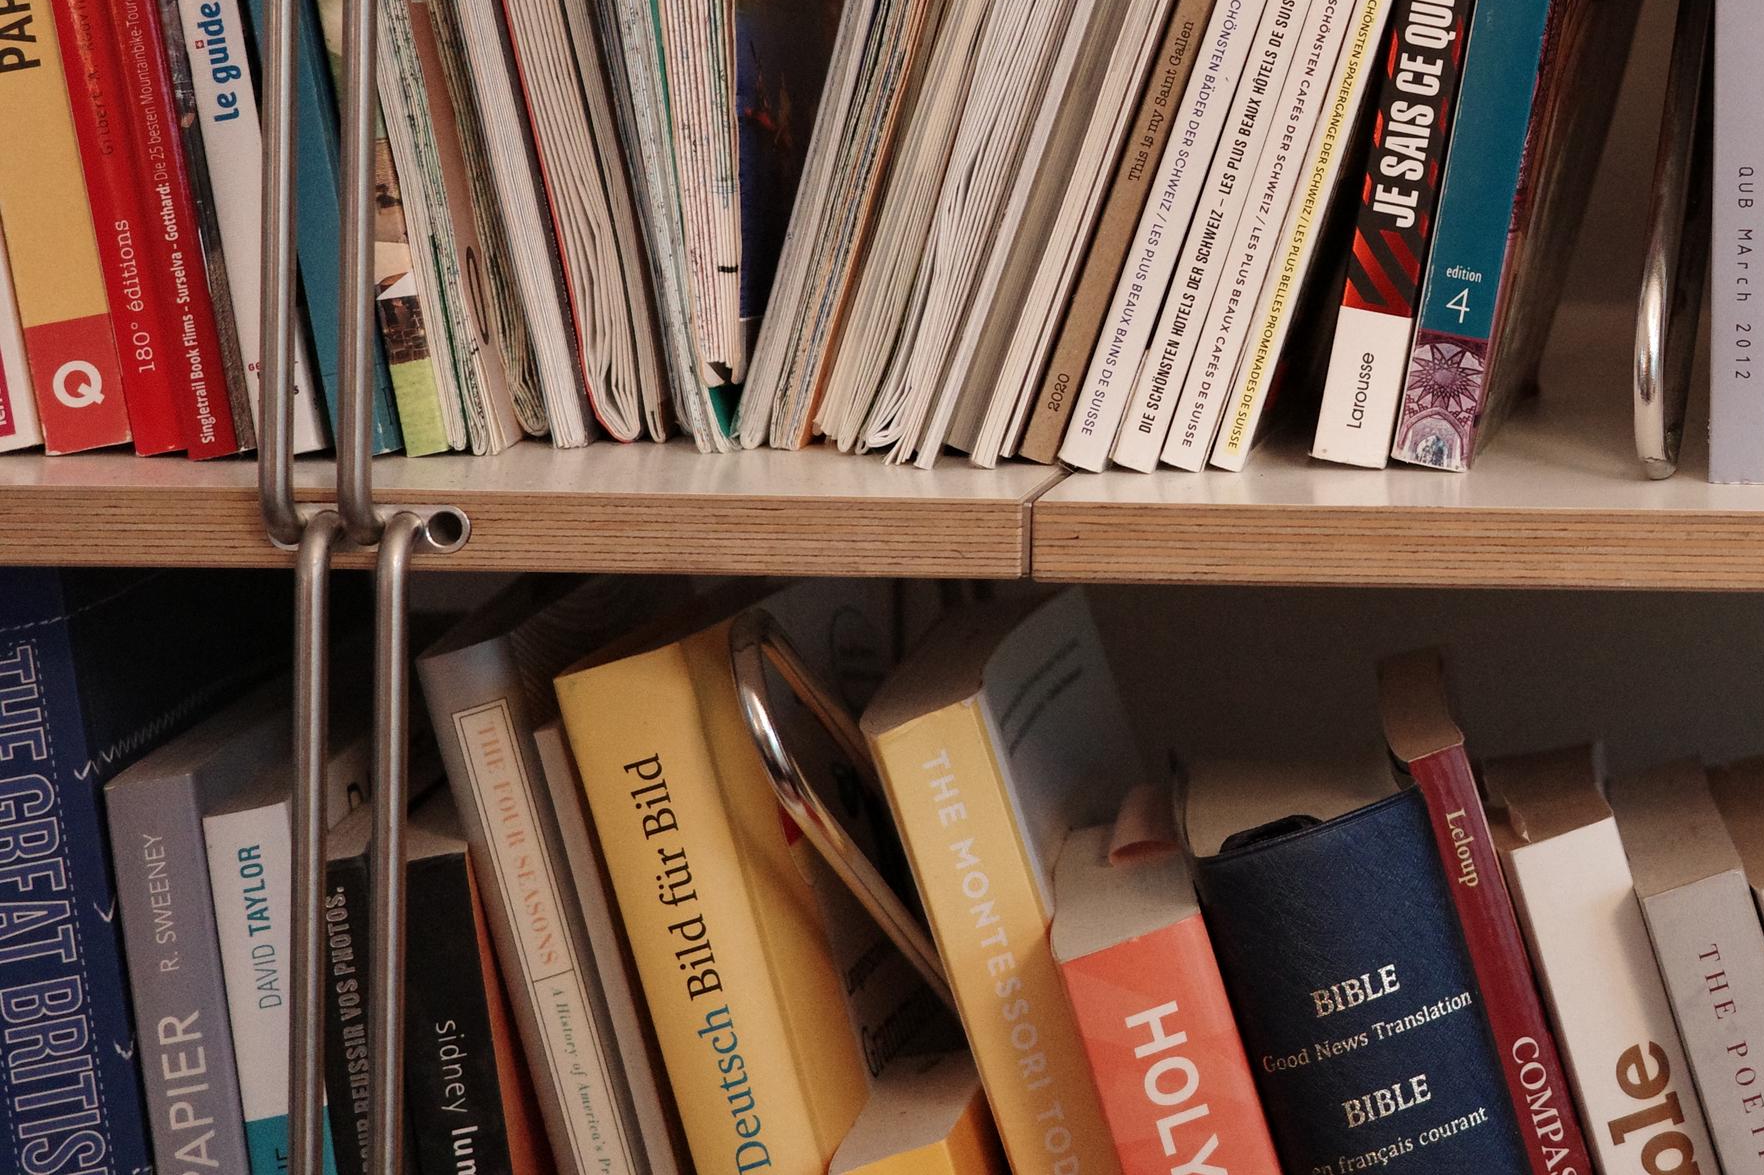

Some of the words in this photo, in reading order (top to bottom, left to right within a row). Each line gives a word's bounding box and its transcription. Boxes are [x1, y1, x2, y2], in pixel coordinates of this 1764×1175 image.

[197, 1, 242, 84] guide
[1168, 21, 1194, 65] Gallen
[1268, 30, 1284, 47] DE
[1154, 68, 1176, 106] Saint
[1252, 50, 1277, 94] HÔTELS
[1396, 52, 1448, 97] CE
[1140, 135, 1153, 148] is
[1147, 108, 1164, 133] my
[1238, 97, 1261, 136] BEAUX
[1380, 96, 1435, 181] SAIS
[1127, 150, 1148, 180] This
[1226, 139, 1247, 170] PLUS
[1218, 172, 1235, 194] LES
[1373, 183, 1420, 228] JE
[1738, 165, 1754, 209] QUB
[155, 182, 178, 240] Gotthard:
[1195, 209, 1223, 263] SCHWEIZ
[115, 220, 143, 311] éditions
[170, 252, 189, 303] Surselva
[1186, 266, 1204, 290] DER
[1446, 266, 1482, 283] edition
[182, 314, 197, 346] Flims
[1170, 292, 1195, 336] HOTELS
[1446, 288, 1470, 324] 4
[130, 322, 156, 373] 180°
[186, 348, 203, 379] Book
[1735, 324, 1752, 379] 2012
[52, 360, 105, 408] Q
[1047, 373, 1069, 412] 2020
[1150, 340, 1180, 410] SCHÖNSTEN
[1346, 352, 1374, 428] Larousse
[191, 381, 214, 443] Singletrail
[1138, 412, 1155, 433] DIE
[623, 754, 678, 838] Bild
[478, 724, 501, 776] THE
[492, 781, 526, 849] FOUR
[513, 855, 559, 966] SEASONS
[1446, 808, 1478, 886] Leloup
[143, 834, 175, 943] SWEENEY
[237, 845, 270, 936] TAYLOR
[656, 847, 697, 905] für
[921, 748, 967, 827] THE
[950, 837, 1057, 1091] MONTESSORI
[160, 951, 179, 971] R.
[251, 944, 281, 1008] DAVID
[668, 915, 722, 999] Bild
[1701, 943, 1736, 1019] THE
[1313, 964, 1399, 1015] BIBLE
[1263, 1048, 1309, 1069] Good
[1314, 1032, 1368, 1060] News
[1371, 992, 1471, 1039] Translation
[435, 1020, 467, 1112] sidney
[698, 1007, 770, 1173] Deutsch
[1342, 1074, 1430, 1126] BIBLE
[1339, 1137, 1413, 1172] français
[1419, 1107, 1487, 1145] courant
